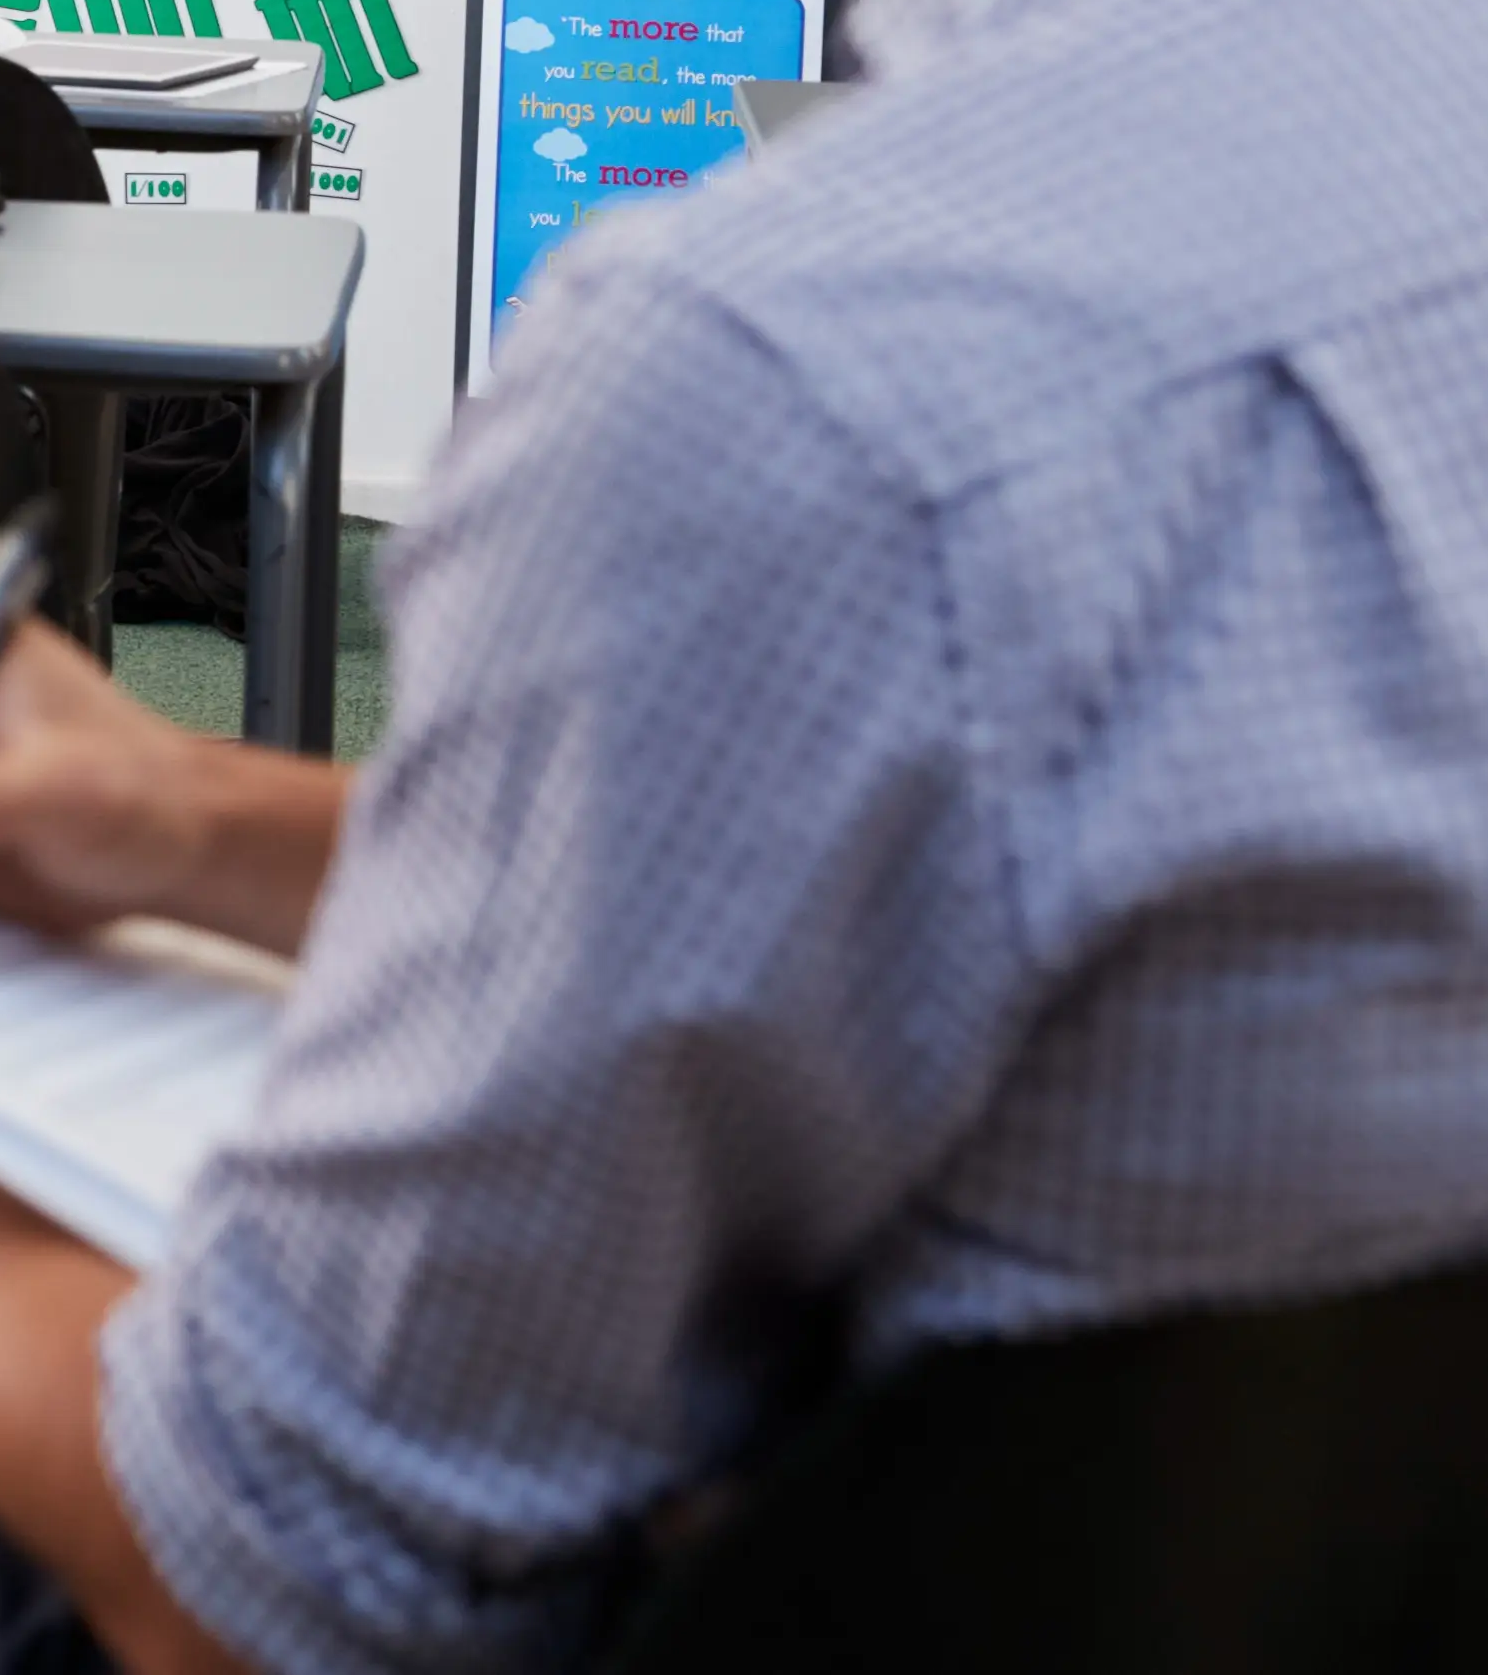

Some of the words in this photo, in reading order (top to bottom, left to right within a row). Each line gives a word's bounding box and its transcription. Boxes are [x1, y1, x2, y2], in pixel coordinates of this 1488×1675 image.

[609, 18, 700, 41] more
[706, 25, 746, 43] that
[544, 65, 575, 82] you
[676, 66, 706, 85] the
[519, 92, 595, 128] things
[606, 104, 652, 128] you
[661, 99, 696, 124] will
[705, 99, 742, 128] kn
[552, 162, 587, 183] The
[599, 165, 690, 188] more
[130, 179, 186, 198] 1/100
[529, 212, 561, 229] you
